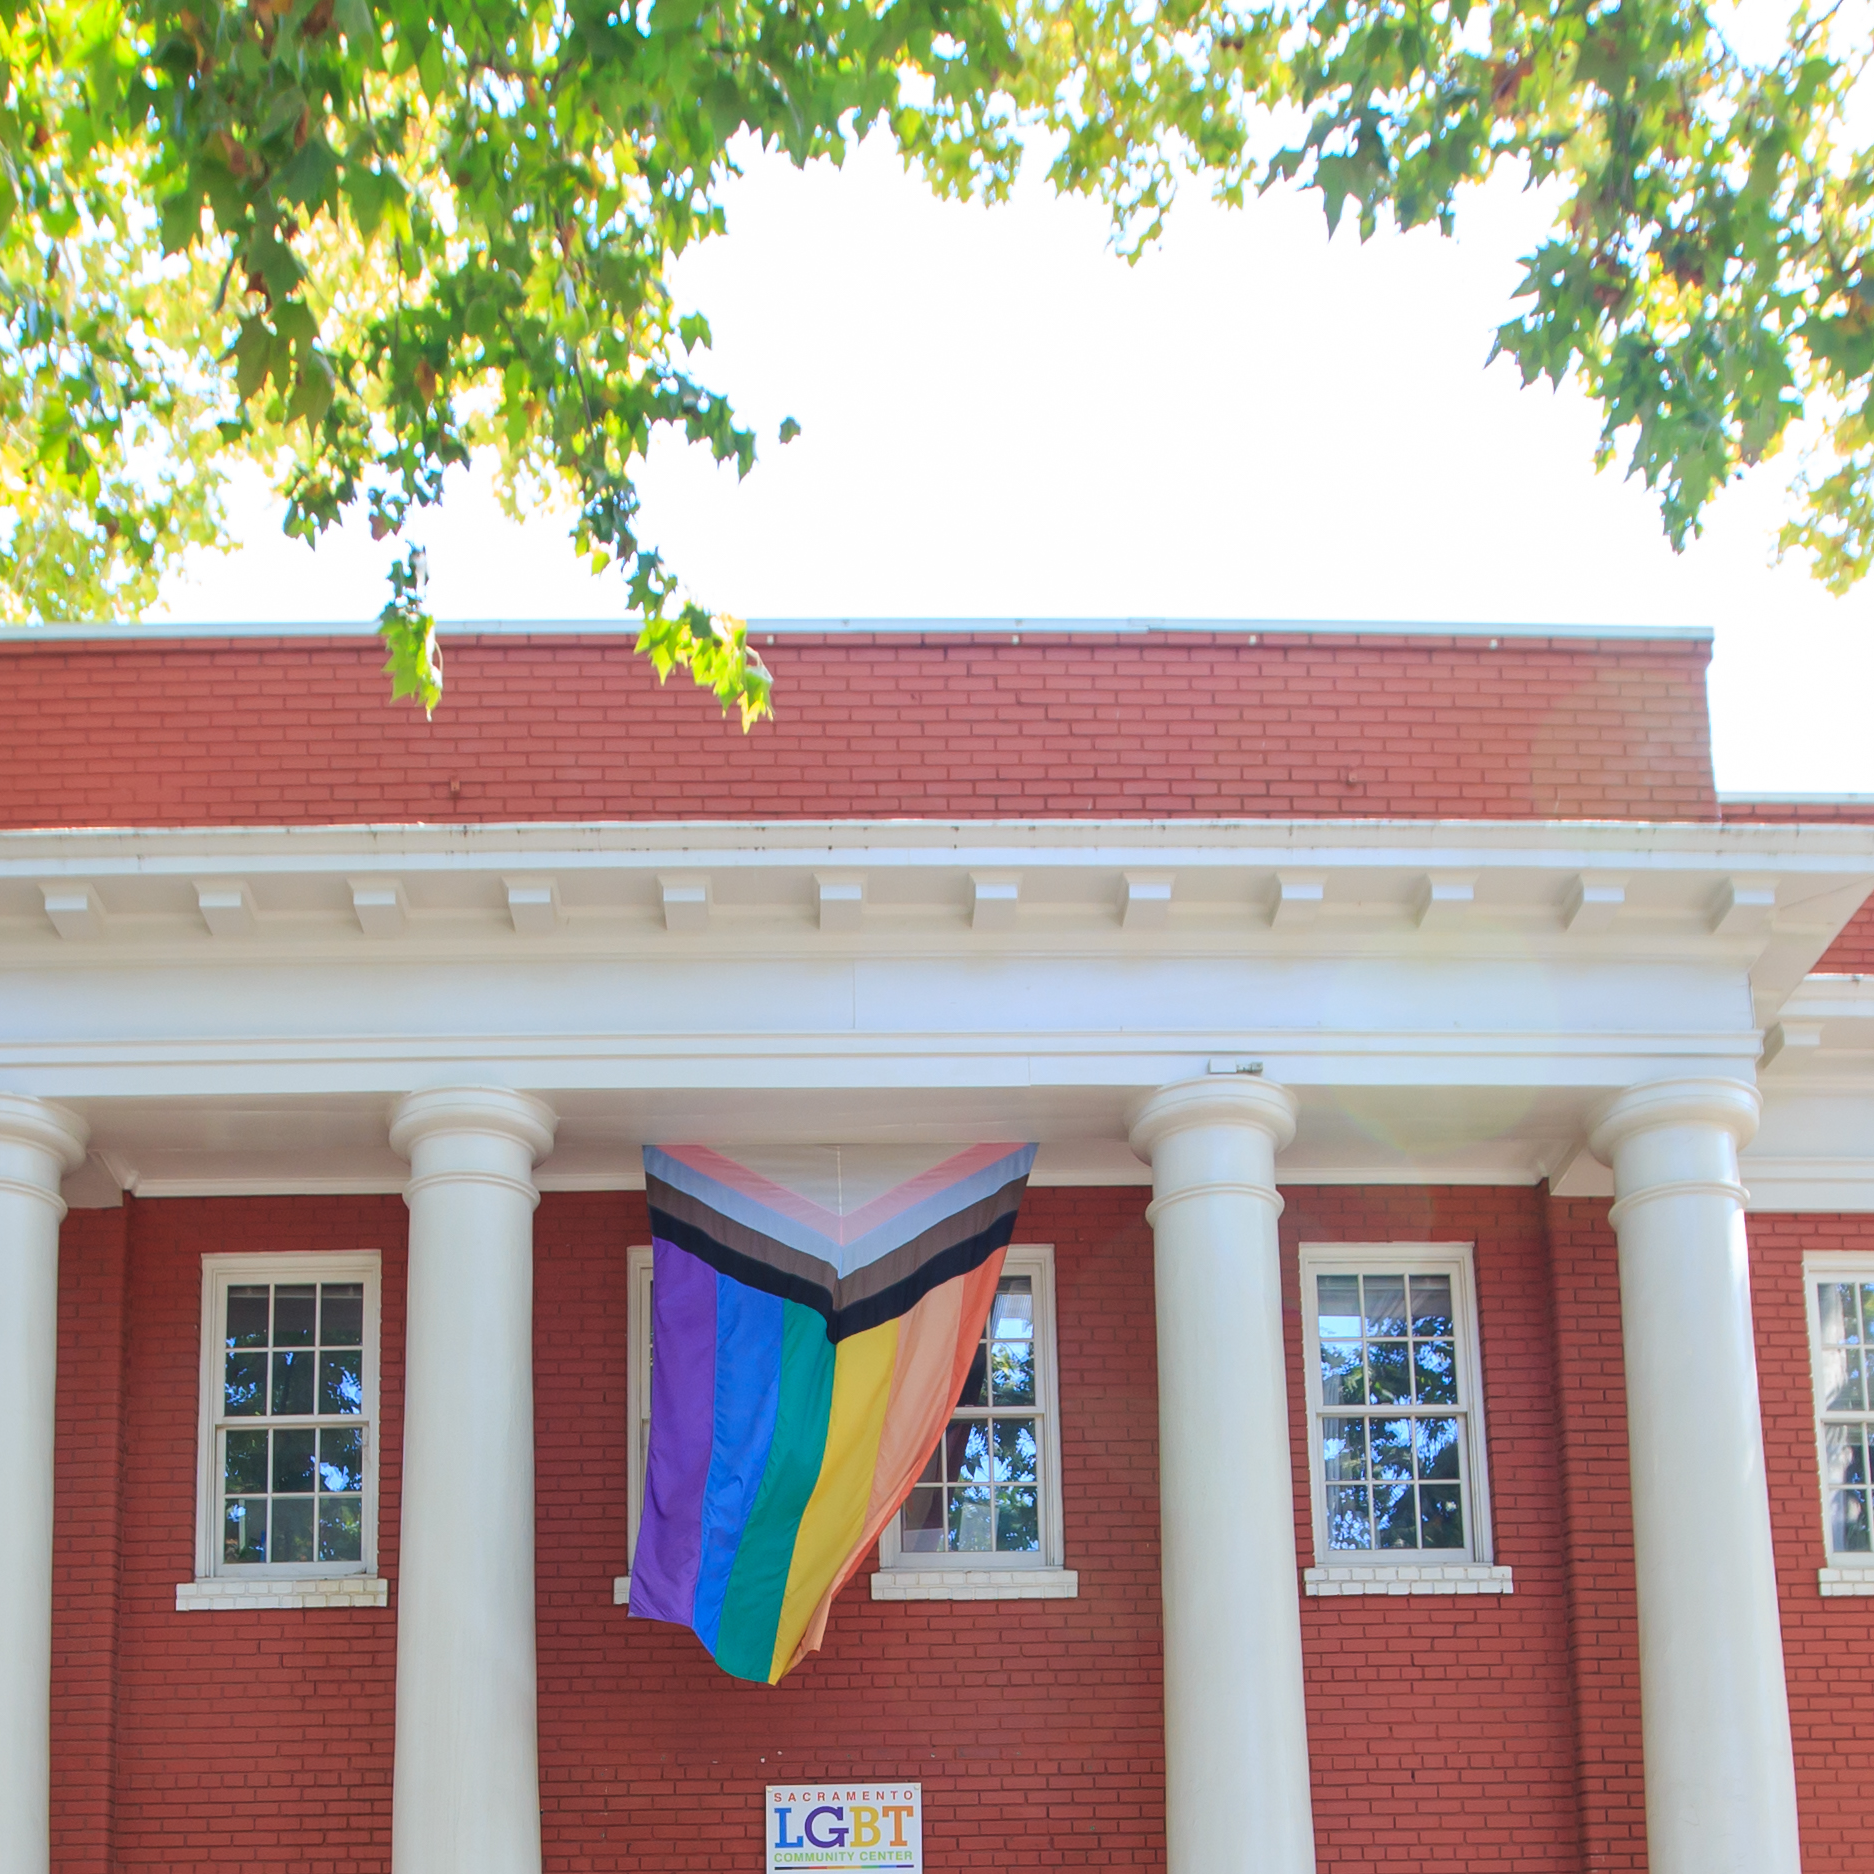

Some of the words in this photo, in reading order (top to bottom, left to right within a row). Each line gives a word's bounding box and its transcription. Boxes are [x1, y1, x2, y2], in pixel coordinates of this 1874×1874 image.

[774, 1790, 914, 1803] SACRAMENTO
[774, 1805, 915, 1849] LGBT
[773, 1851, 855, 1863] COMMUNITY
[859, 1850, 913, 1862] CENTER
